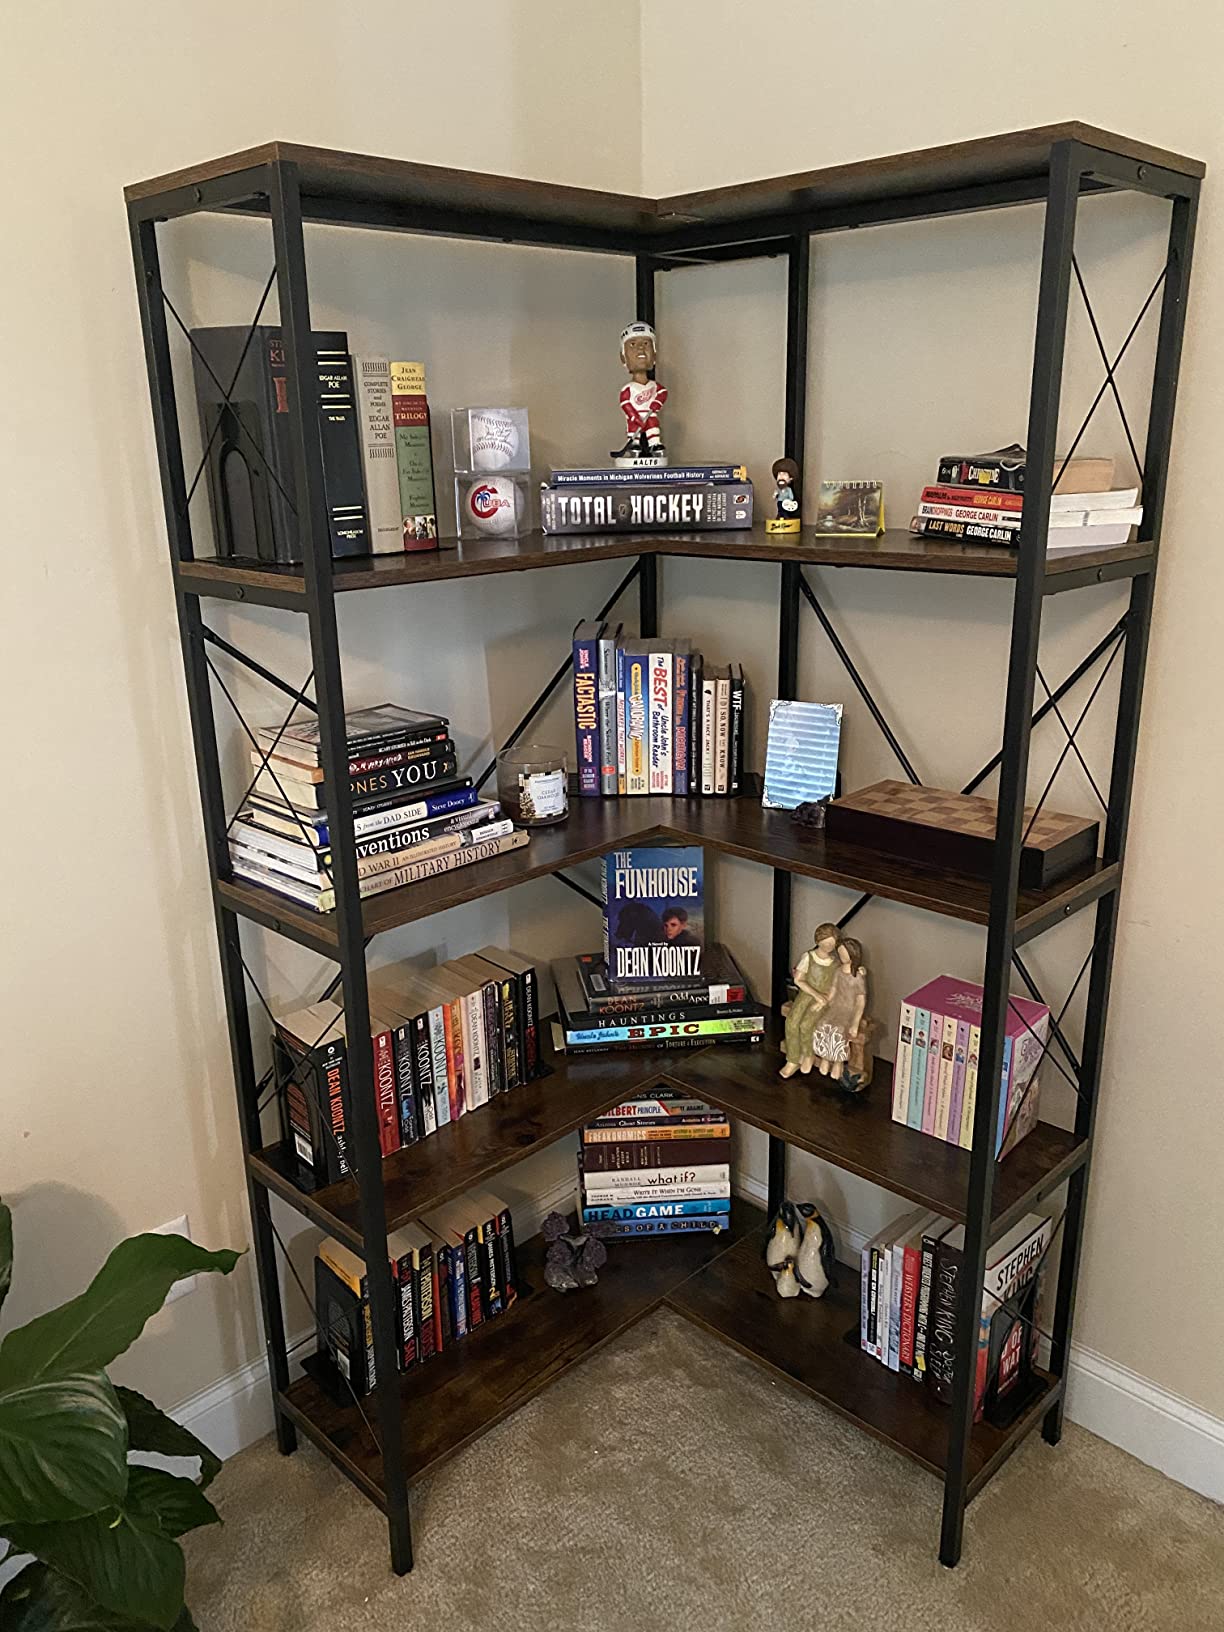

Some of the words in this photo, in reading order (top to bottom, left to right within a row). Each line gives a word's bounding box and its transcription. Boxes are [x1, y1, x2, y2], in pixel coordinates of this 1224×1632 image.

[319, 374, 333, 382] EDGAR
[401, 366, 417, 374] JEAN
[328, 380, 341, 389] POE
[397, 383, 423, 391] GEORGE
[368, 415, 390, 423] EDGAR
[395, 412, 428, 421] TRILOGY
[369, 423, 391, 431] ALLAN
[374, 432, 387, 440] POE
[558, 473, 578, 482] Miracle
[578, 473, 603, 482] Moments
[603, 473, 609, 481] in
[609, 472, 633, 482] Michigan
[633, 472, 664, 481] Wolverines
[664, 471, 685, 480] Football
[686, 470, 705, 481] History
[558, 496, 617, 525] TOTAL
[630, 493, 704, 524] HOCKEY
[955, 509, 977, 520] GEORGE
[978, 511, 999, 522] CARLIN
[928, 520, 944, 531] LAST
[944, 522, 965, 534] WORDS
[966, 525, 989, 538] GEORGE
[989, 527, 1012, 541] CARLIN
[656, 655, 665, 668] The
[652, 666, 669, 706] BEST
[576, 672, 597, 730] FACTASTIC
[731, 690, 743, 711] WTF
[651, 710, 661, 743] Bathroom
[660, 715, 670, 734] Uncle
[718, 722, 728, 737] NOW
[660, 734, 670, 757] John's
[650, 743, 661, 769] Reader
[391, 760, 438, 788] YOU
[383, 812, 402, 825] DAD
[403, 807, 423, 819] SIDE
[431, 801, 447, 813] Steve
[368, 860, 391, 876] WAR
[392, 857, 400, 867] II
[394, 856, 450, 887] MILITARY
[455, 839, 502, 868] HISTORY
[613, 851, 634, 869] THE
[614, 866, 699, 900] FUNHOUSE
[616, 946, 650, 978] DEAN
[651, 946, 702, 978] KOONTZ
[607, 994, 639, 1006] DEAN
[670, 991, 690, 1003] Odd
[526, 1002, 535, 1028] KOONTZ
[599, 1002, 647, 1016] KOONTZ
[598, 1011, 687, 1029] HAUNTINGS
[627, 1023, 700, 1040] EPIC
[472, 1029, 481, 1056] KOONTZ
[665, 1040, 687, 1050] TORTURE
[417, 1043, 433, 1090] KOONTZ
[433, 1038, 448, 1083] KOONTZ
[326, 1068, 341, 1097] DEAN
[378, 1062, 395, 1111] KOONTZ
[398, 1054, 412, 1102] KOONTZ
[330, 1095, 346, 1136] KOONTZ
[637, 1105, 662, 1115] PRINCIPLE
[588, 1129, 647, 1143] FREAKONOMICS
[647, 1172, 678, 1186] what
[680, 1171, 696, 1184] if?
[588, 1209, 634, 1222] HEAD
[635, 1204, 685, 1219] GAME
[636, 1224, 652, 1232] OF
[671, 1220, 717, 1229] CHILD
[996, 1232, 1045, 1292] STEPHEN
[420, 1272, 433, 1321] PATTERSON
[903, 1273, 915, 1311] WEBSTER'S
[402, 1302, 415, 1343] PATTERSON
[934, 1308, 957, 1345] KING
[901, 1309, 913, 1360] DICTIONARY
[1011, 1325, 1024, 1347] OF
[403, 1338, 416, 1368] SAIL
